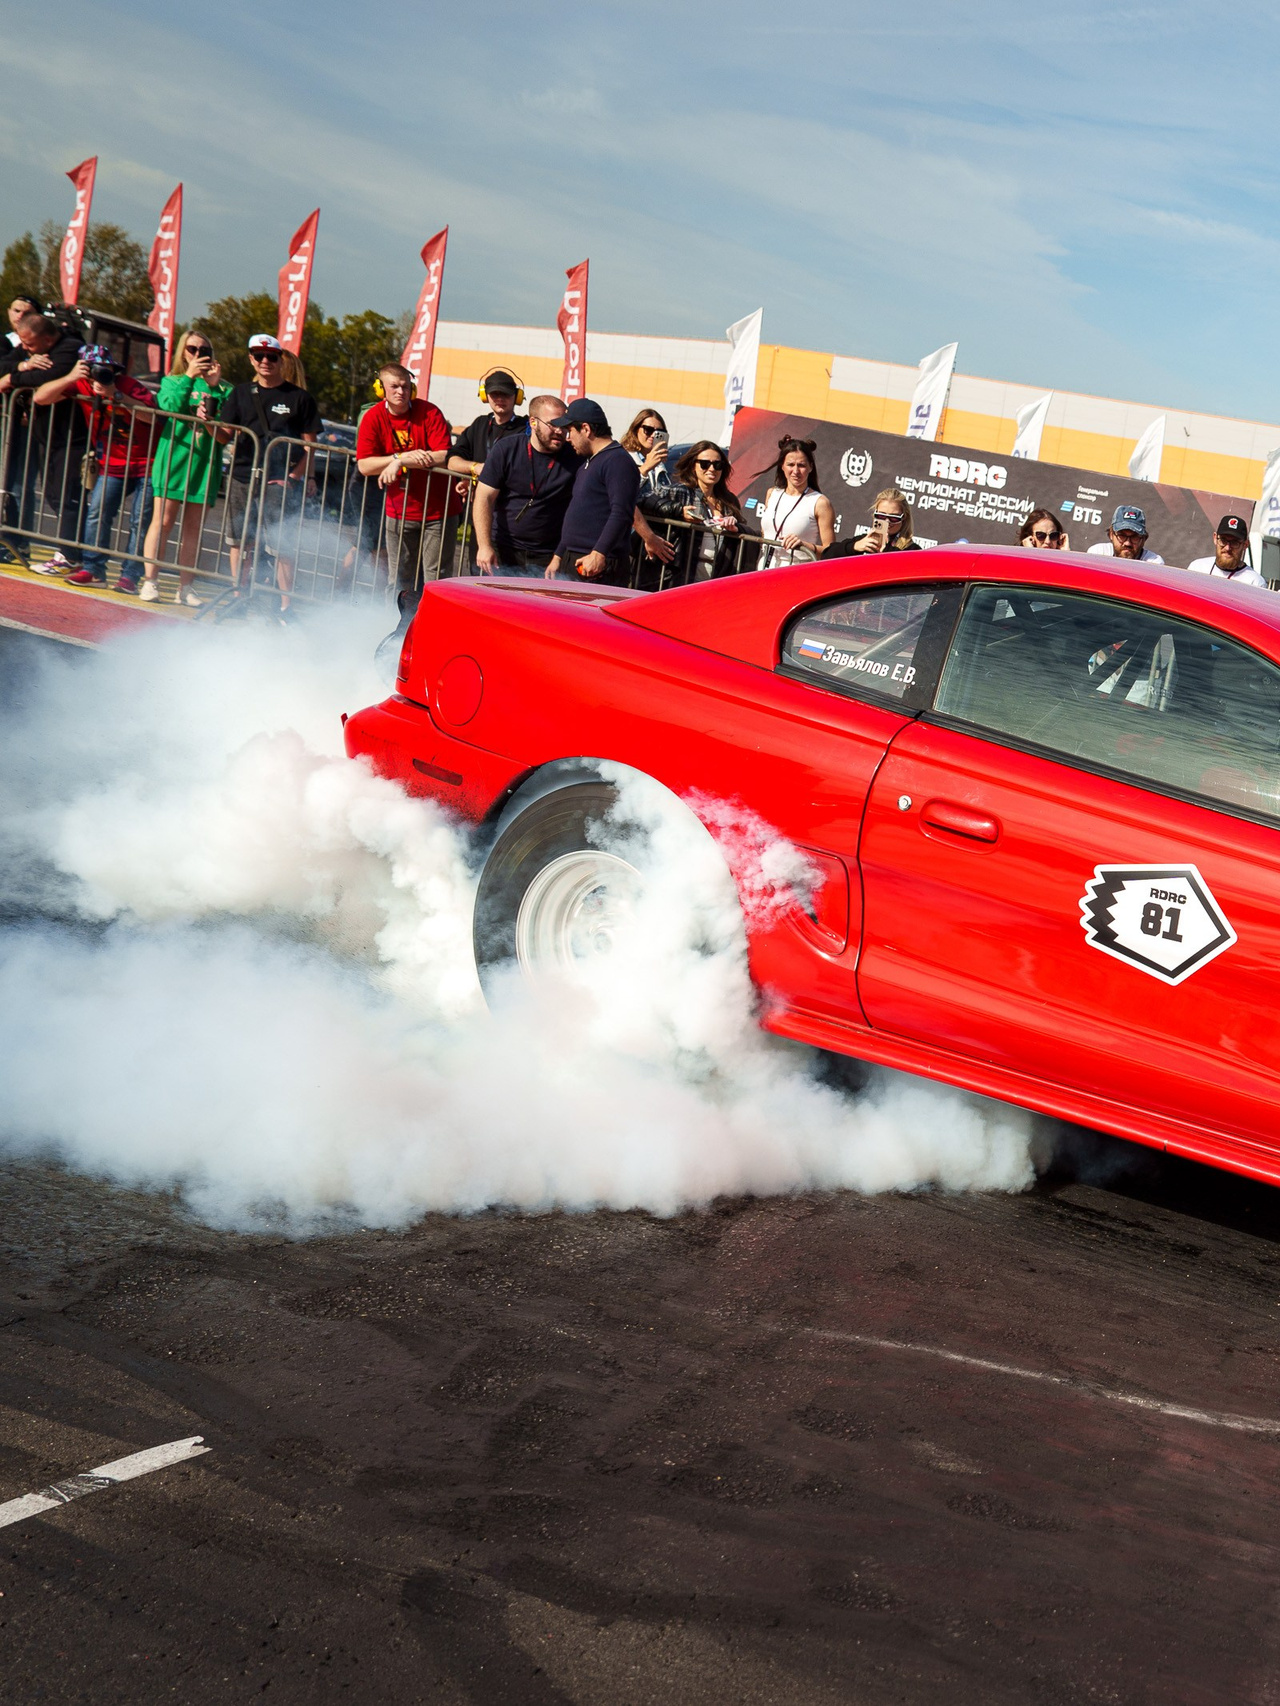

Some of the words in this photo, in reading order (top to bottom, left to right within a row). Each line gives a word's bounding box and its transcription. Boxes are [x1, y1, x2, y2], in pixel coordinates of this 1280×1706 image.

[929, 453, 1007, 489] RDRC
[895, 475, 976, 502] ЧЕМПИОНАТ
[978, 491, 1036, 513] РОССИИ
[917, 495, 1029, 527] ДРЭГ-РЕЙСИНГУ
[1072, 505, 1102, 525] ВТБ
[822, 645, 889, 677] Завьялов
[891, 663, 916, 686] Е.В.
[1150, 887, 1187, 905] RDRC
[1140, 901, 1183, 943] 81
